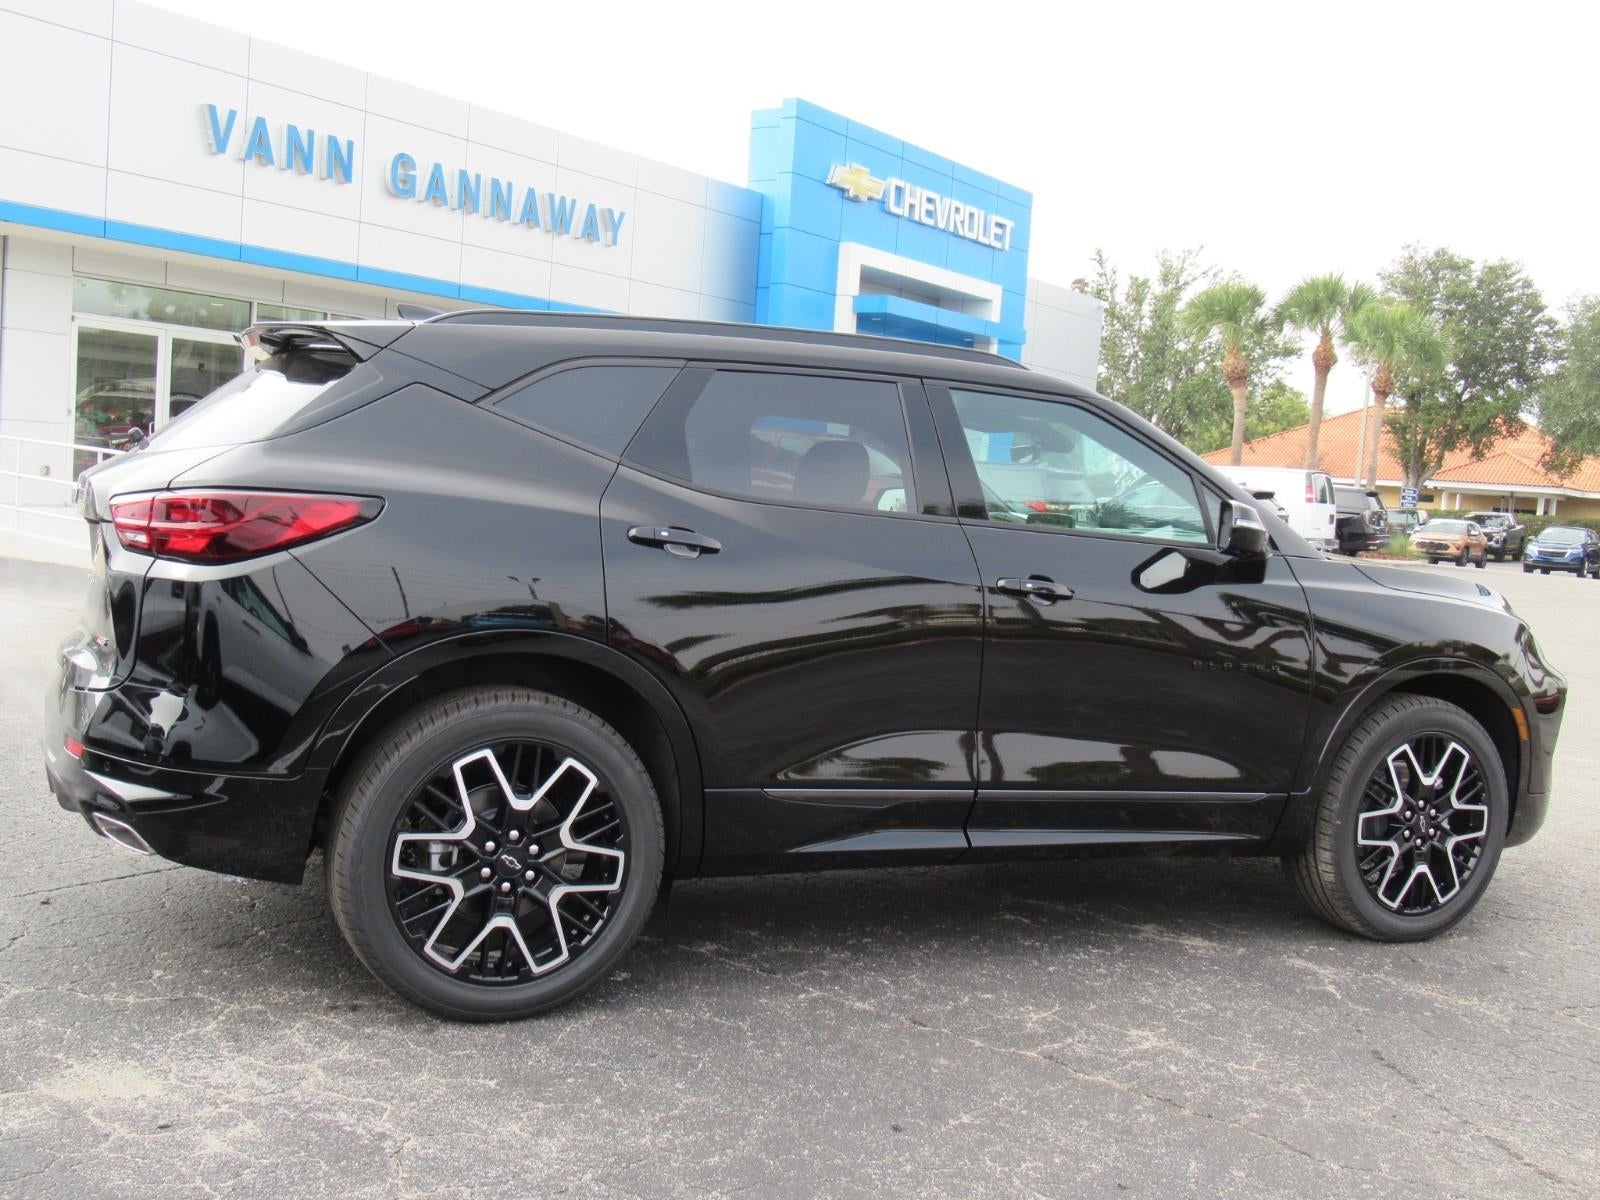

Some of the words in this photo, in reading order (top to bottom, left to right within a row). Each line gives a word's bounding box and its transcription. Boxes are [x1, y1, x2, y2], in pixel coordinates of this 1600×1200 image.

[203, 103, 355, 185] VANN
[386, 152, 626, 247] GANNAWAY
[885, 177, 1015, 251] CHEVROLET
